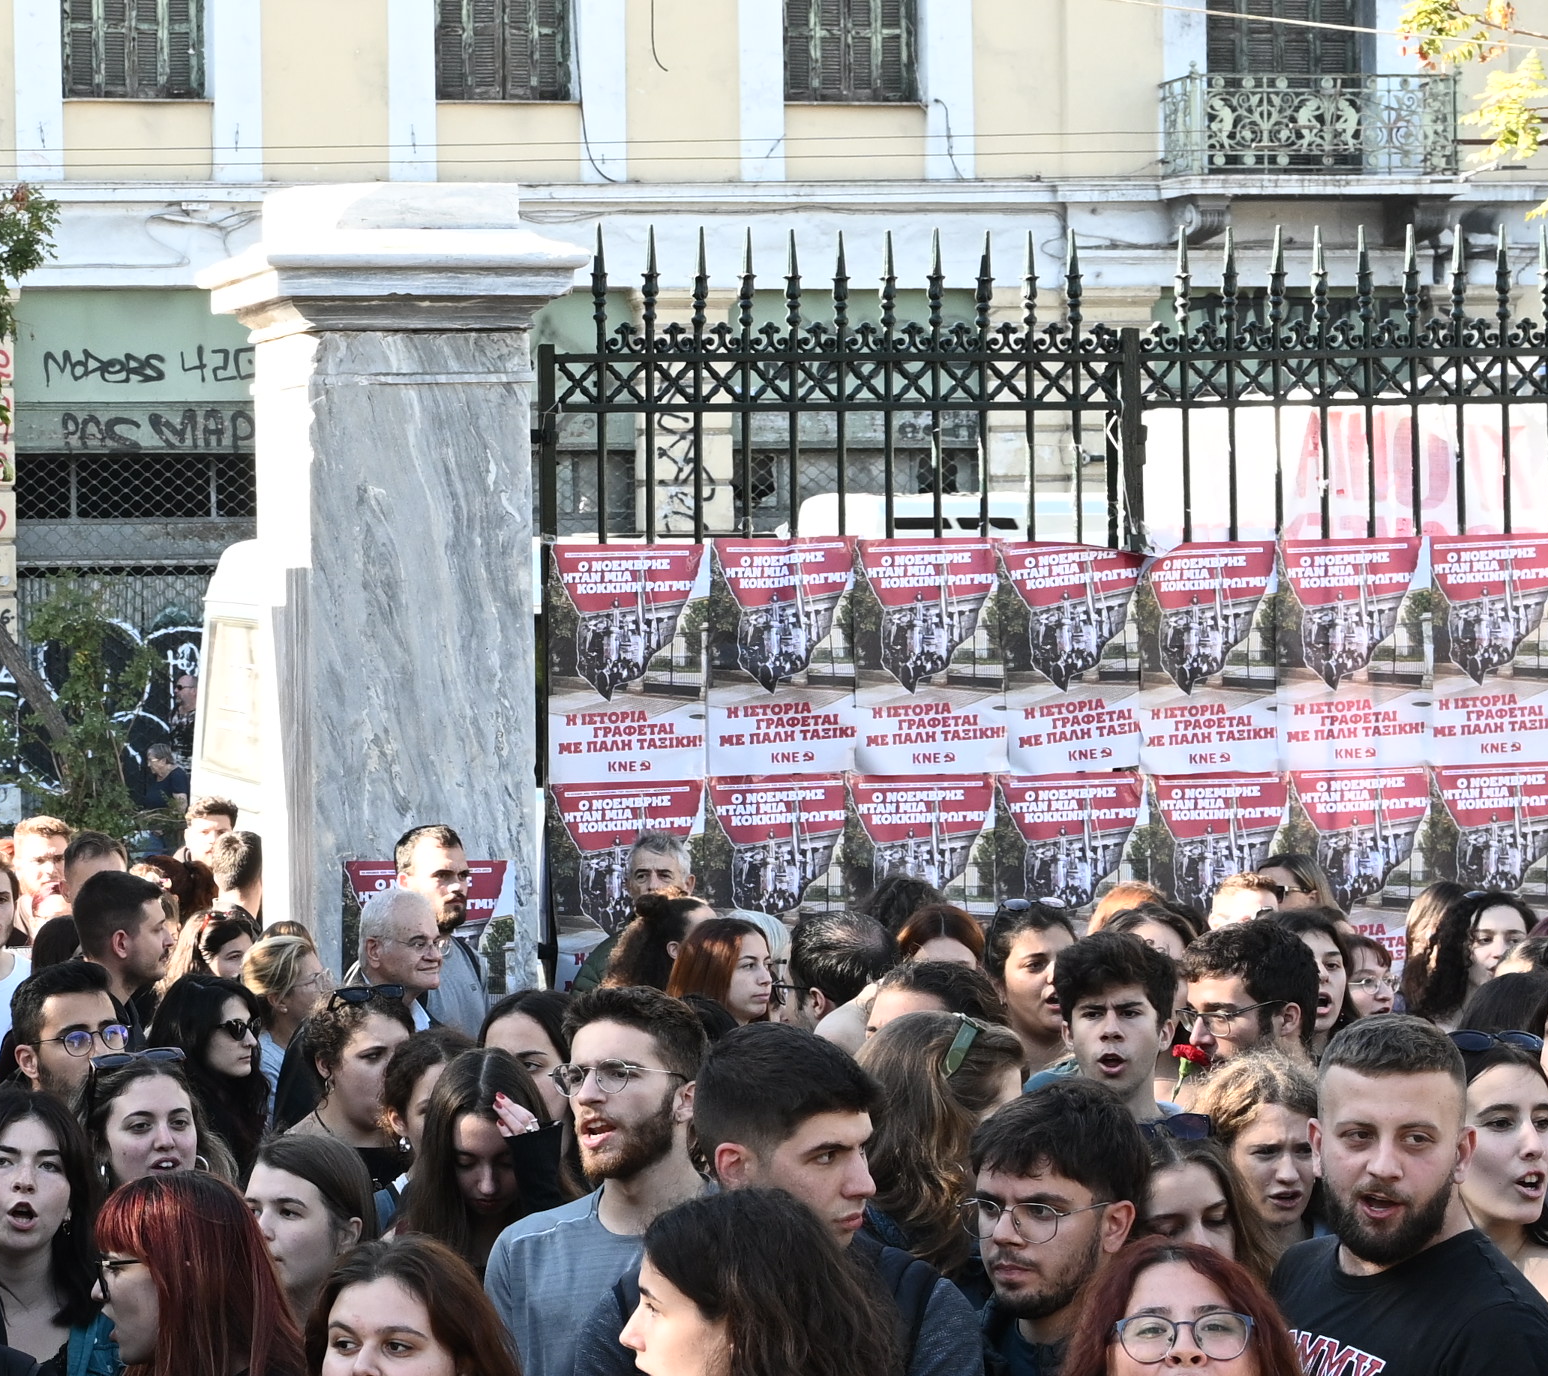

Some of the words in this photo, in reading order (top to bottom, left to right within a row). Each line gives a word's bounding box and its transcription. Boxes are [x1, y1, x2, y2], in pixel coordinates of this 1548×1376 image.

[881, 556, 892, 566] Ο
[895, 552, 971, 565] ΝΟΕΜΒΡΗΣ
[867, 567, 904, 578] ΗΤΑΝ
[908, 566, 935, 576] ΜΙΑ
[881, 576, 945, 588] ΚΟΚΚΙΝΗ
[947, 573, 998, 585] ΡΩΓΜΗ
[873, 708, 885, 719] Η
[887, 702, 951, 717] ΙΣΤΟΡΙΑ
[898, 714, 978, 730] ΓΡΑΦΕΤΑΙ
[866, 735, 889, 747] ΜΕ
[892, 730, 940, 745] ΠΑΛΗ
[944, 726, 1005, 741] ΤΑΞΙΚΗ!
[913, 753, 941, 764] ΚΝΕ
